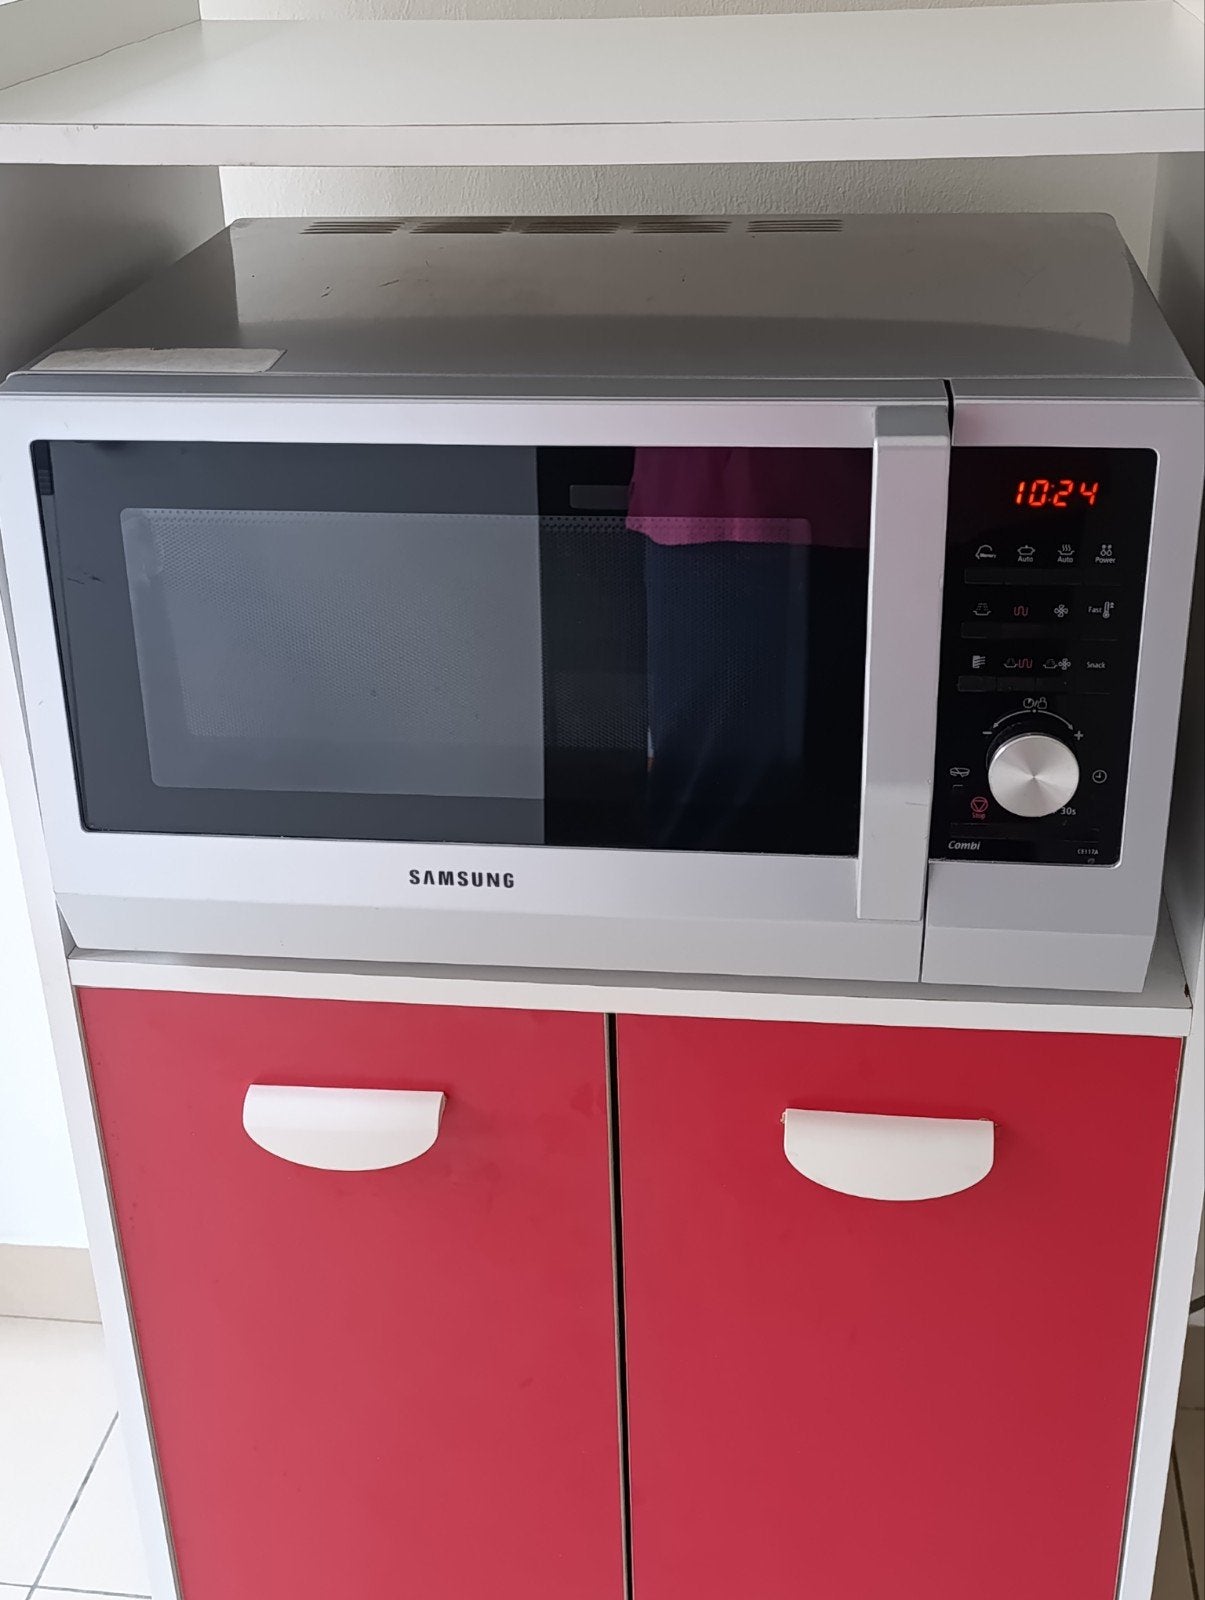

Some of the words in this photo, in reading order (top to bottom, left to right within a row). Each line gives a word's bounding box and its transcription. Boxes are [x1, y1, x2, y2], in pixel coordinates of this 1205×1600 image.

[1016, 480, 1099, 507] 10:24
[1017, 555, 1034, 563] Auto
[1095, 556, 1116, 564] Power
[1087, 661, 1106, 669] Snack
[972, 812, 985, 820] Stop
[948, 840, 980, 851] Combi
[409, 869, 515, 889] SAMSUNG
